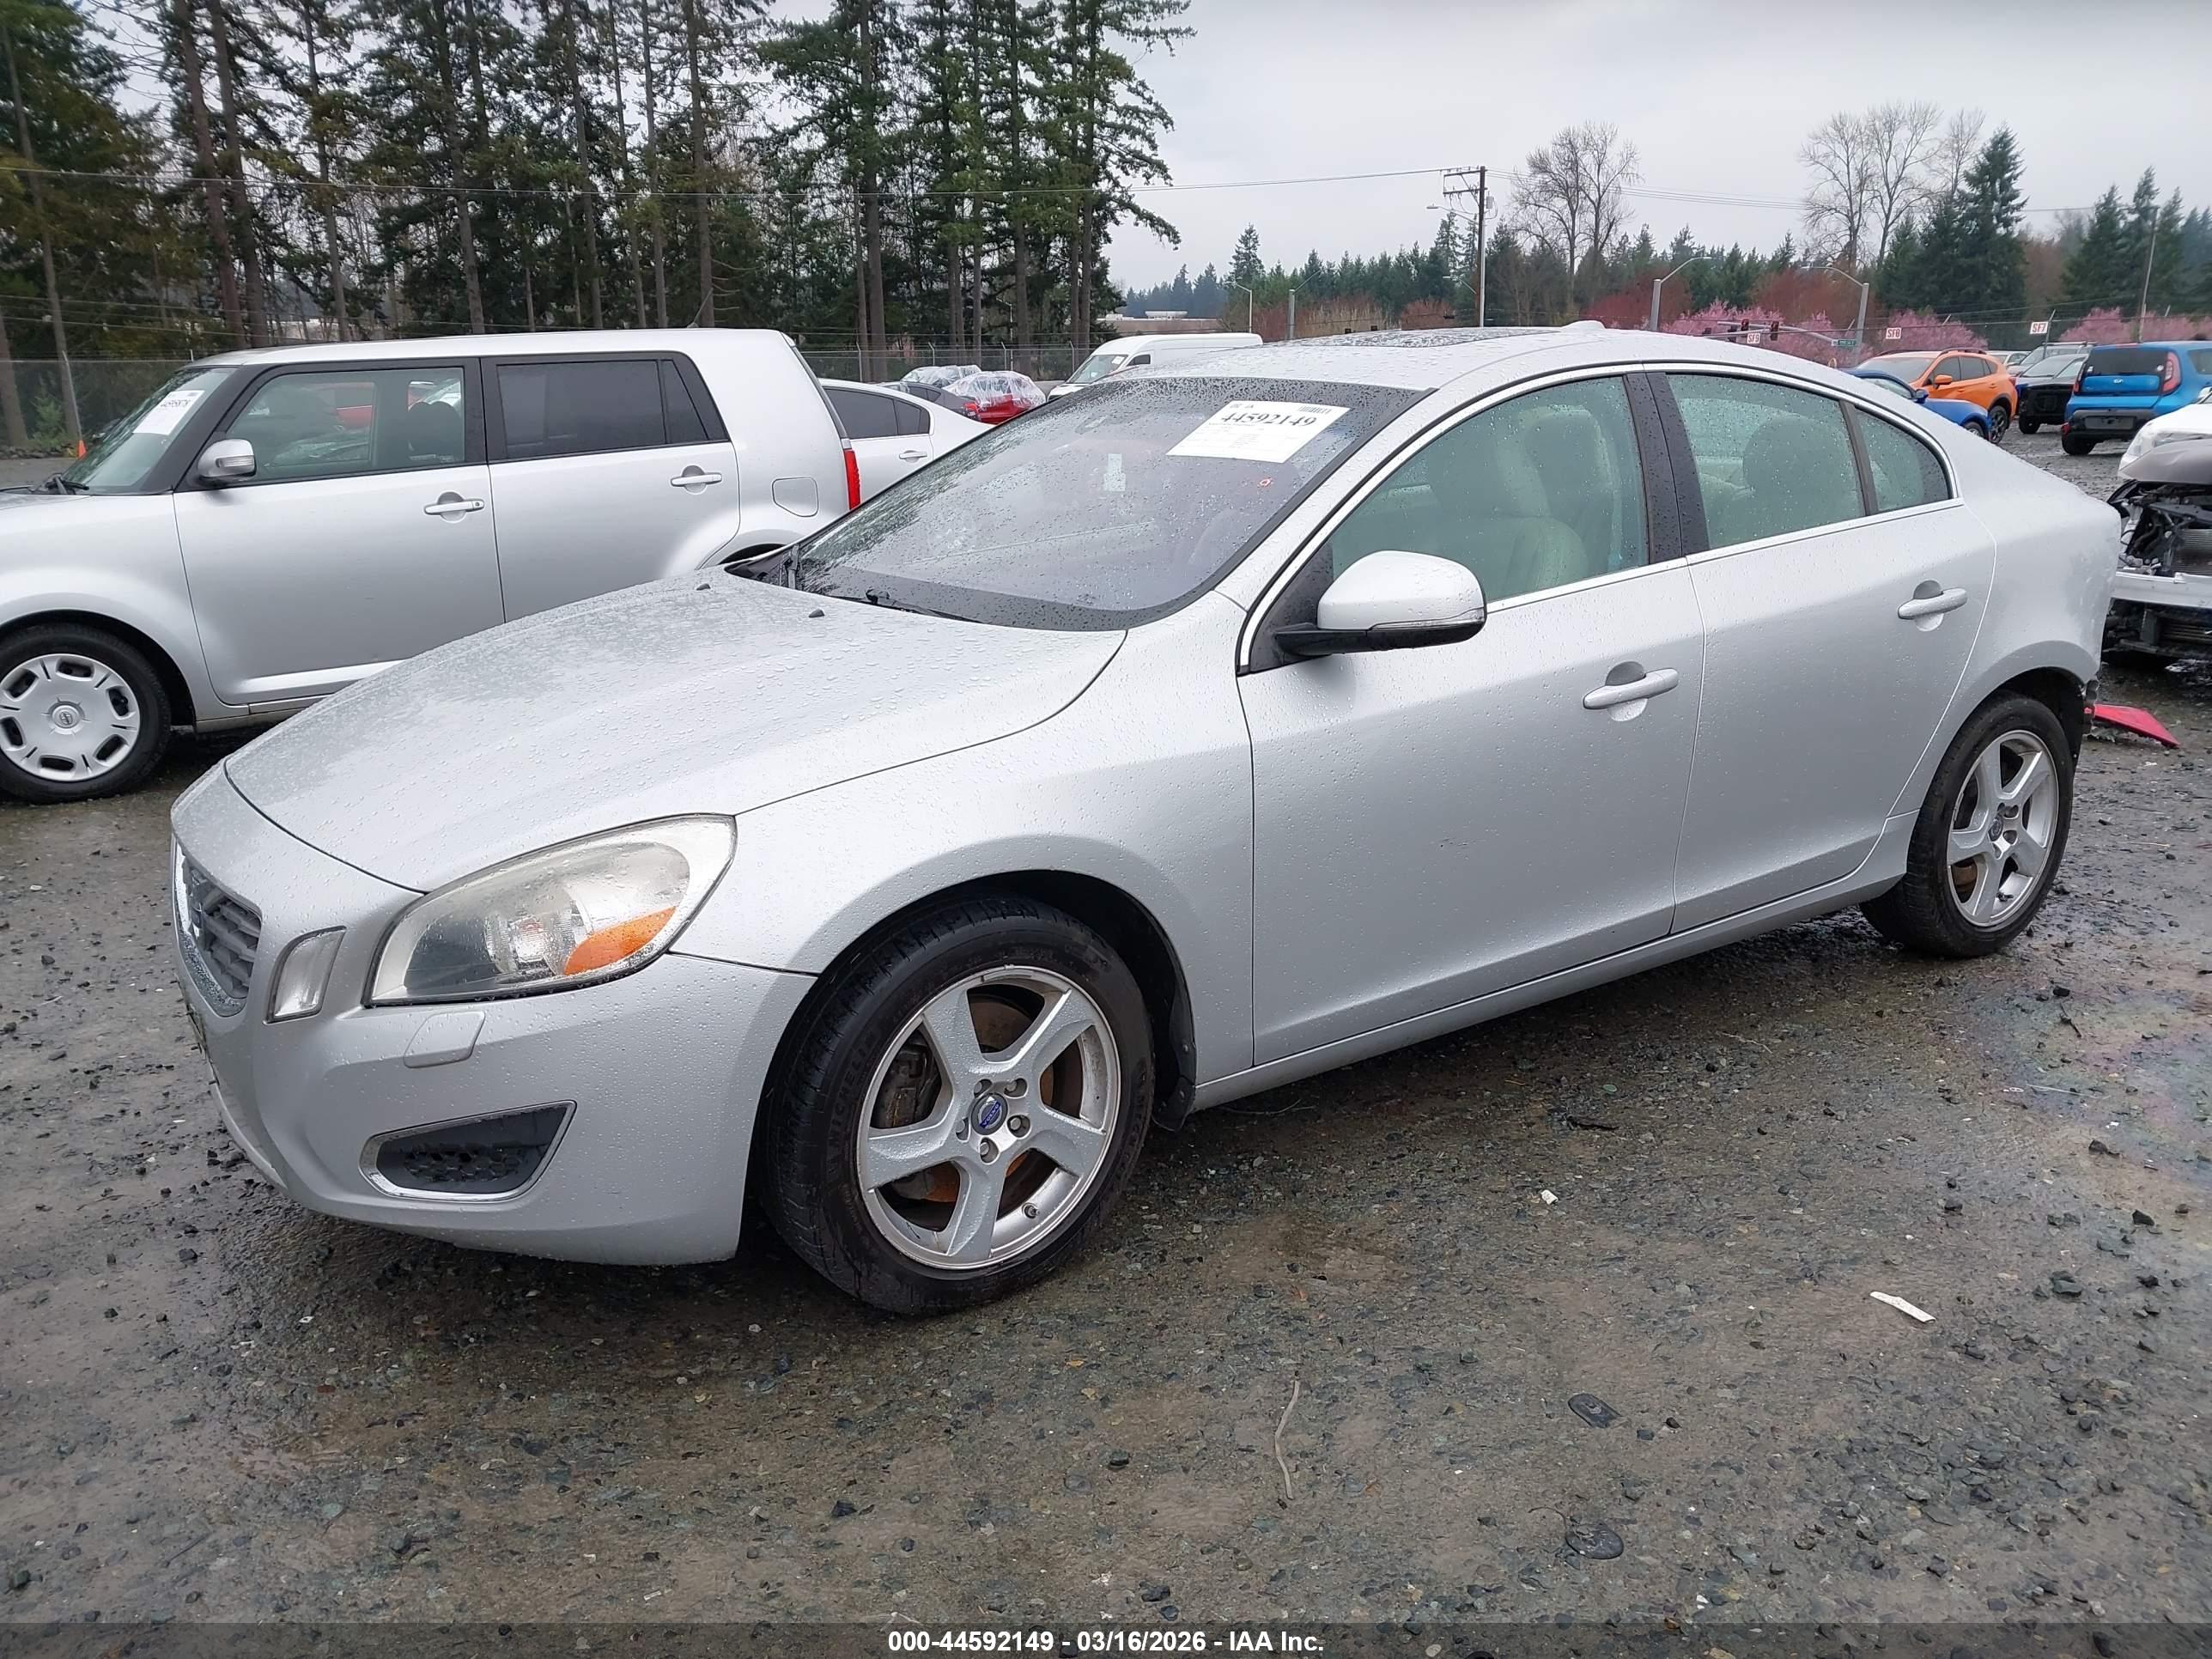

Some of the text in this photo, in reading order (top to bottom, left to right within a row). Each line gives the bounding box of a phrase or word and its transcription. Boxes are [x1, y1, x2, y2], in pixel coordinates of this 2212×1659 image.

[2032, 323, 2047, 333] SF7
[1748, 334, 1759, 343] SF9
[1221, 412, 1317, 426] 44592149
[982, 1103, 1000, 1127] VOLVO
